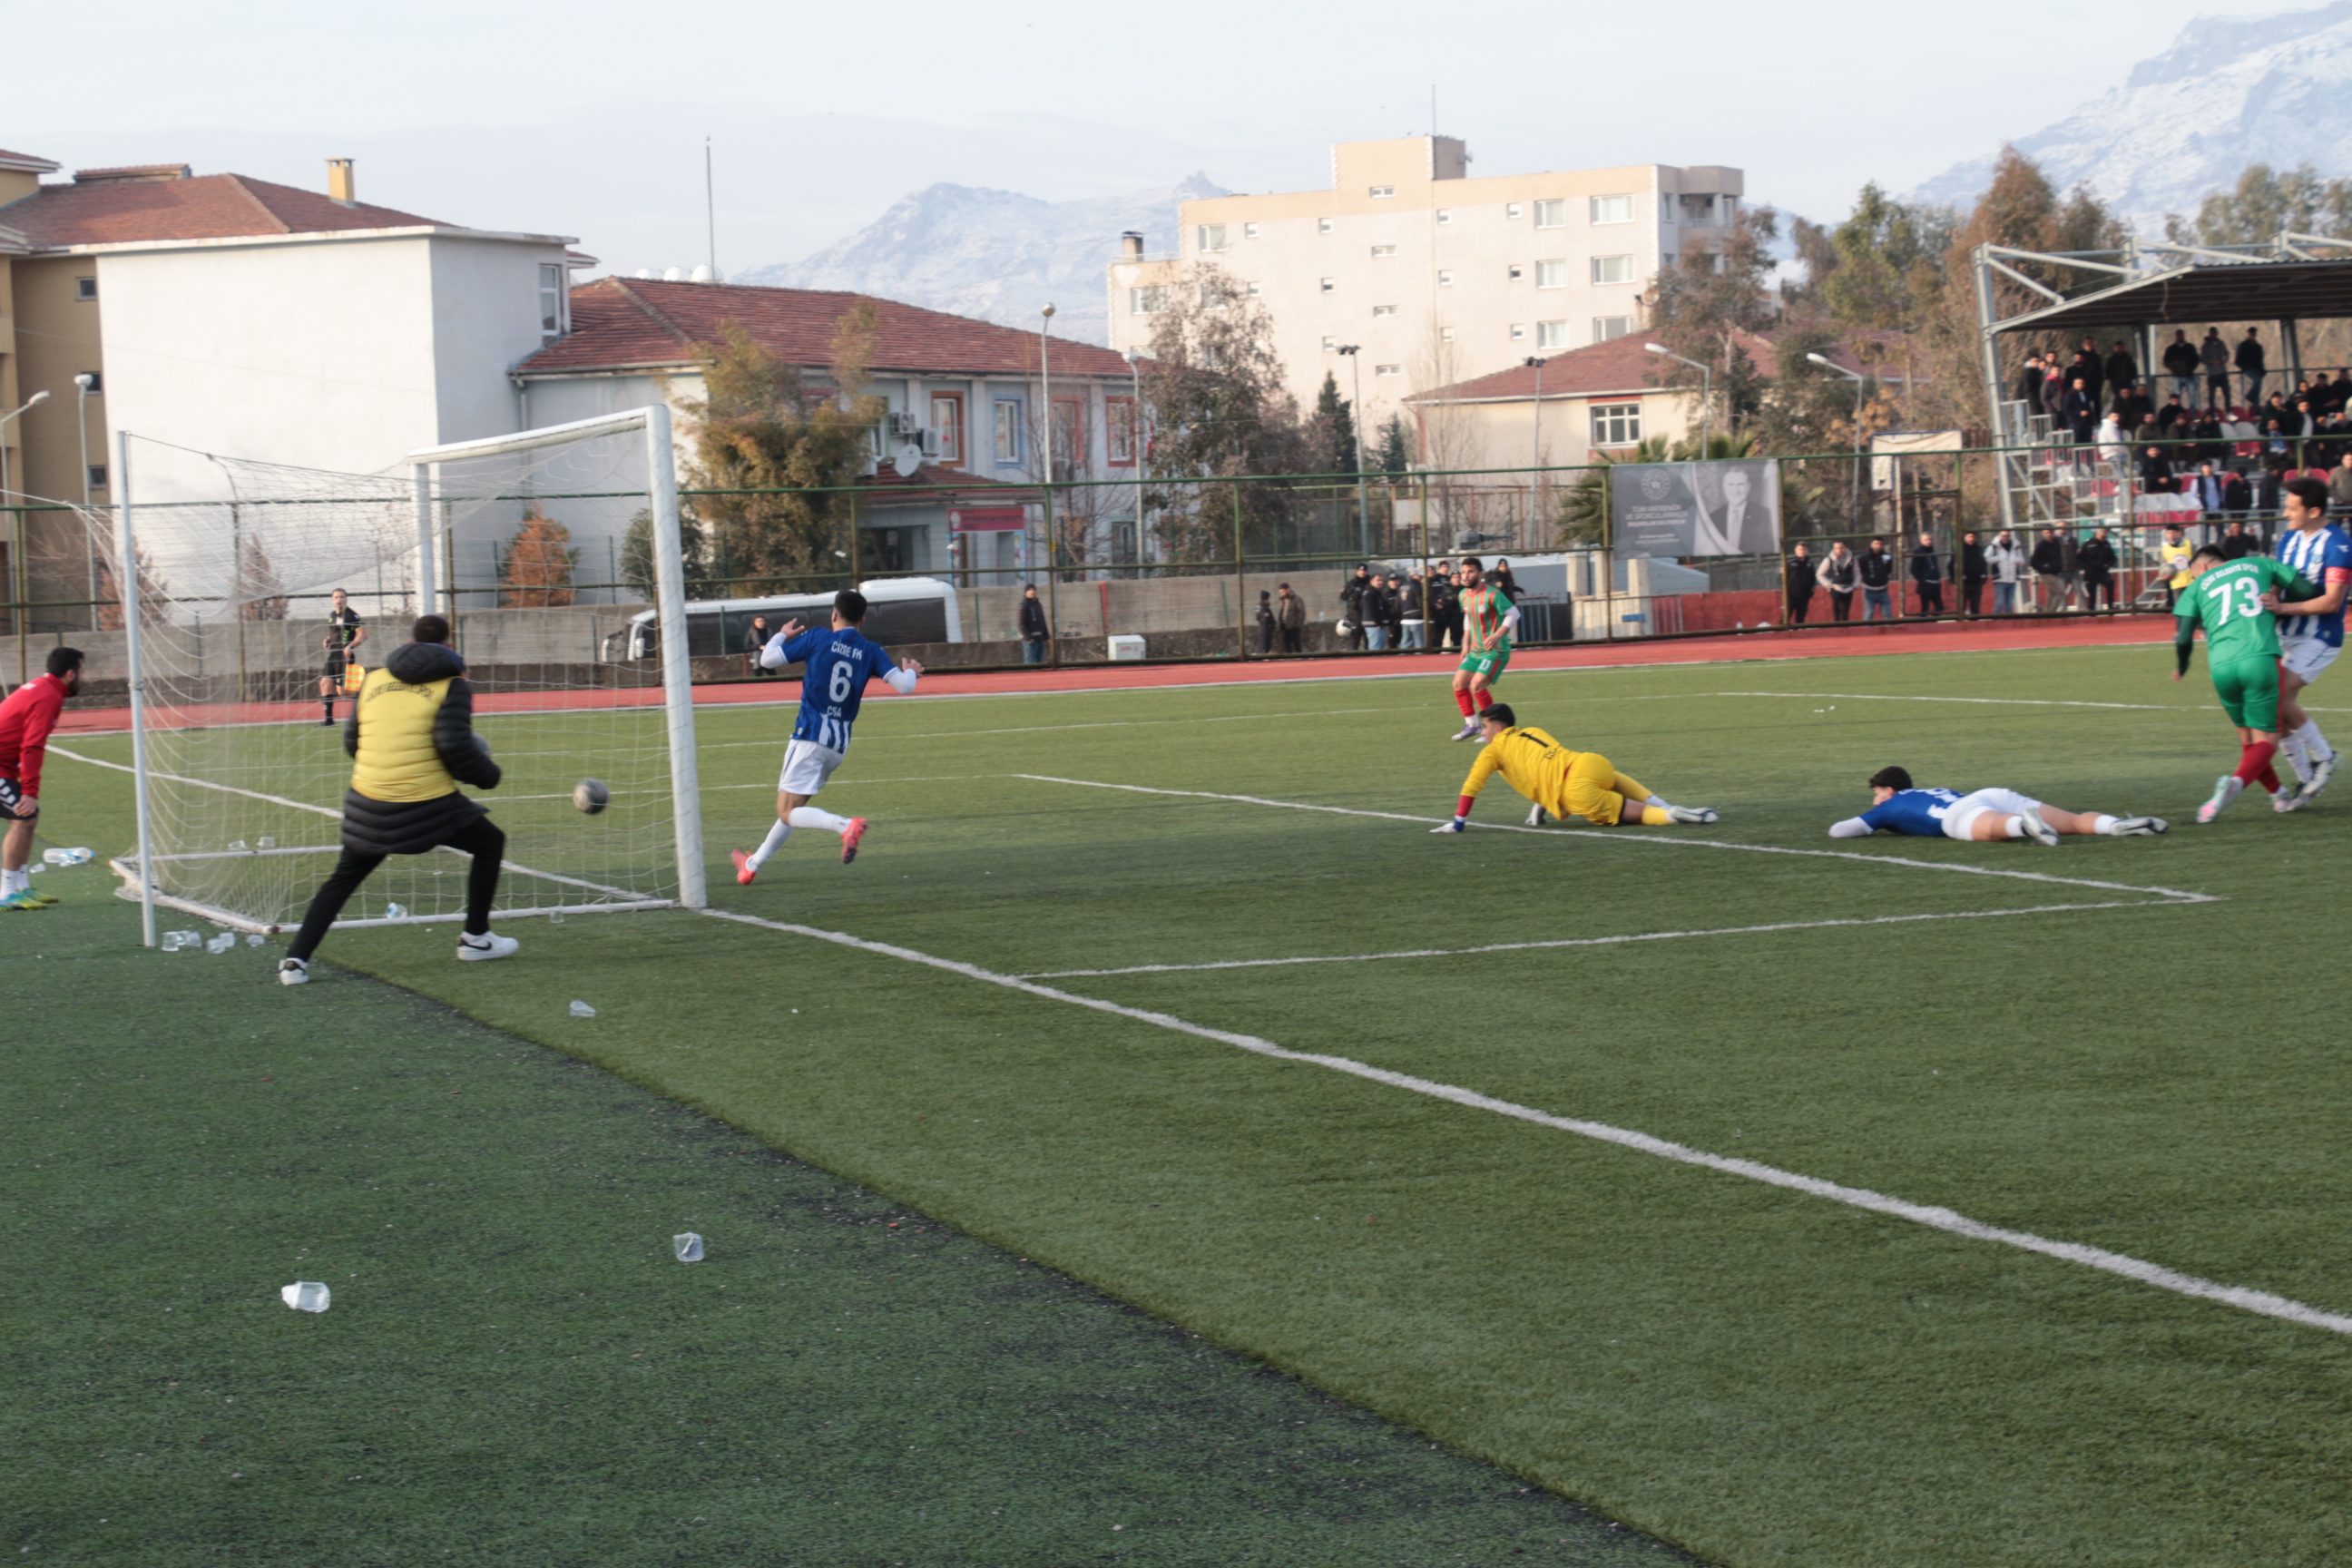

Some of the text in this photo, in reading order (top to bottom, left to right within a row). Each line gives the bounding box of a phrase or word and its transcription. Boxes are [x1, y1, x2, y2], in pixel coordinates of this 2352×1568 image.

[2241, 563, 2259, 574] SPOR
[2208, 576, 2264, 626] 73
[831, 640, 863, 661] CİZRE FK
[828, 661, 853, 703] 6
[827, 705, 842, 718] CSA
[1519, 731, 1549, 749] 1
